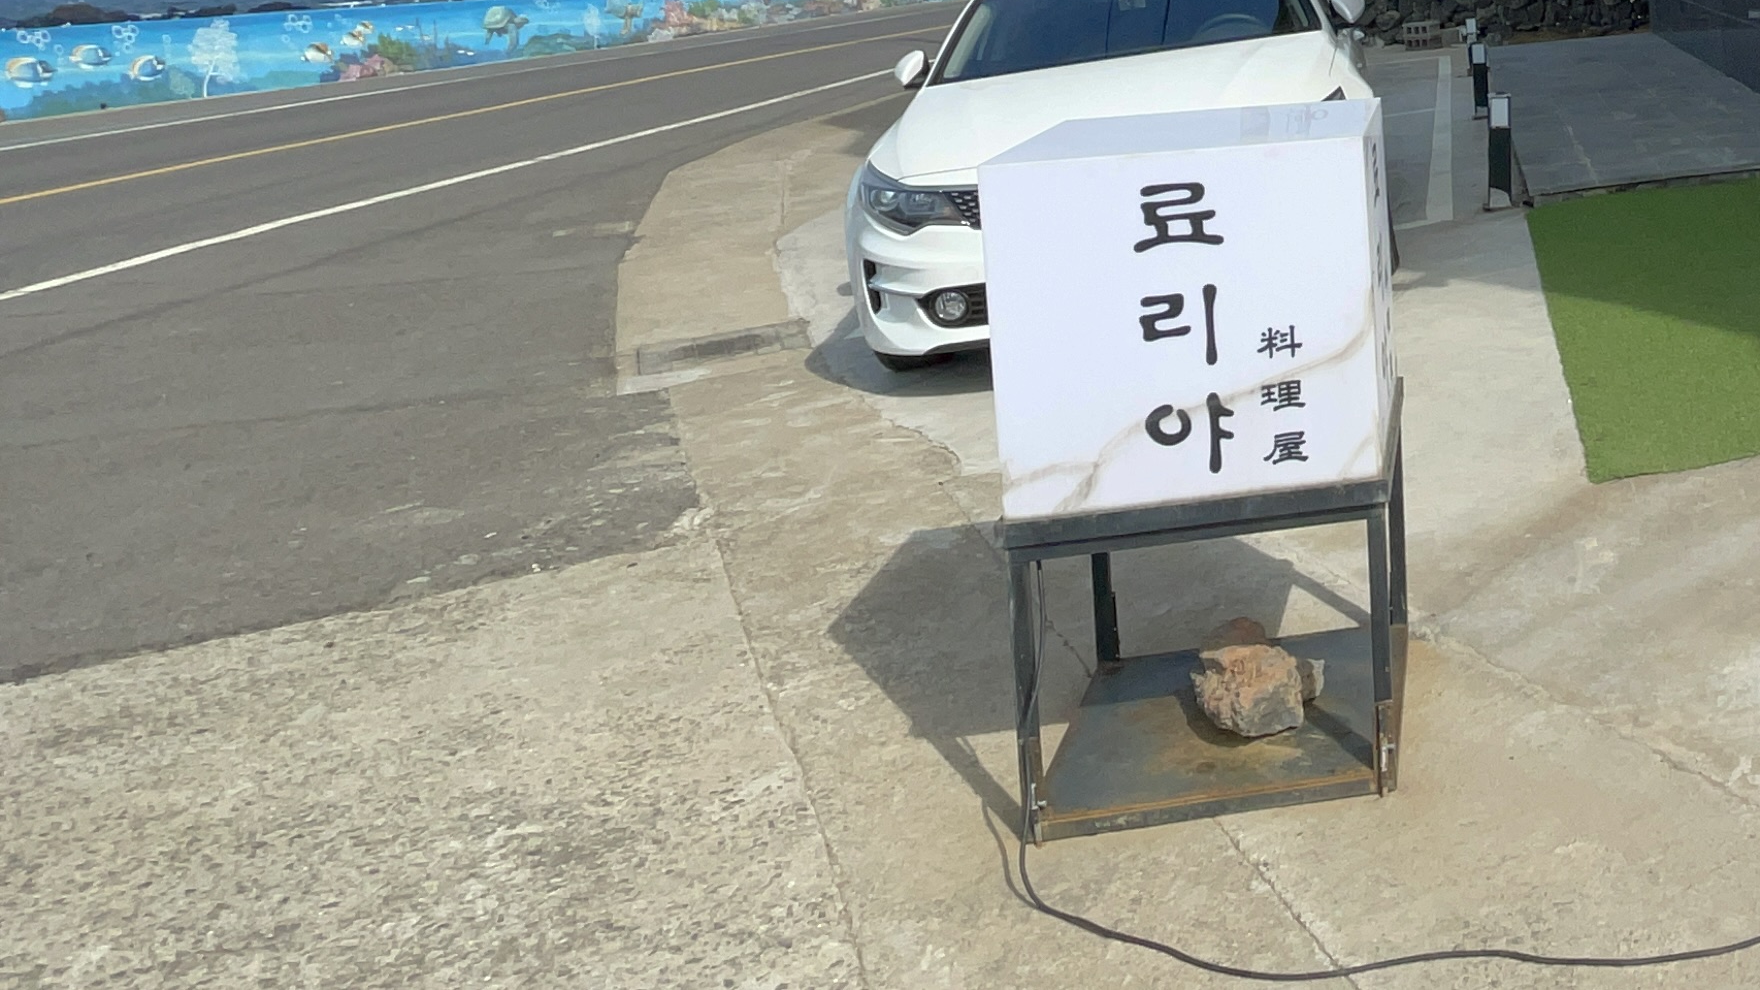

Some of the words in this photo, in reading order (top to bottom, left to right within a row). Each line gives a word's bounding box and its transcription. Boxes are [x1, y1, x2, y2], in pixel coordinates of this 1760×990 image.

[1133, 182, 1235, 475] 료리야
[1256, 324, 1309, 467] 料理屋
